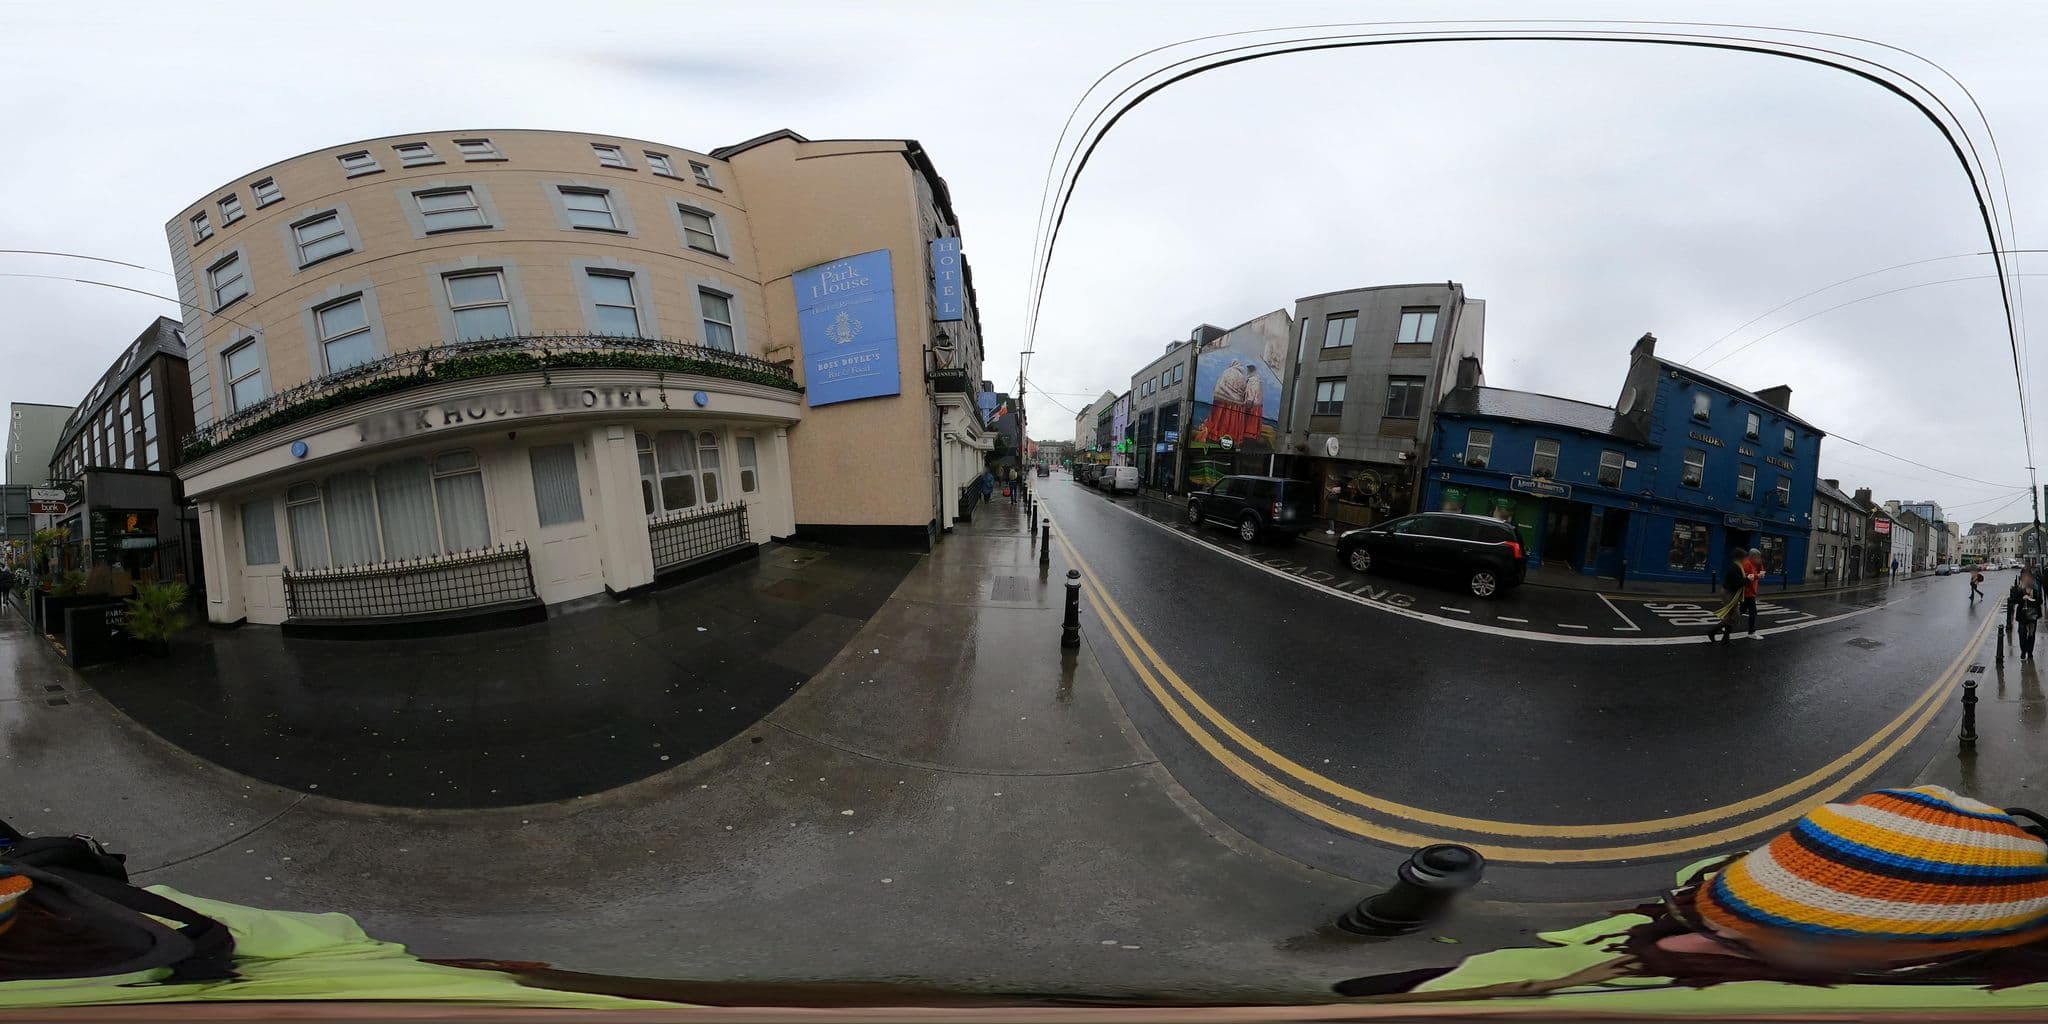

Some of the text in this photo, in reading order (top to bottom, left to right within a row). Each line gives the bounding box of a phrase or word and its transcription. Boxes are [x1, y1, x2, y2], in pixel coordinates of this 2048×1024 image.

[811, 277, 869, 299] House
[821, 265, 860, 295] Park
[940, 243, 955, 313] HOTEL
[841, 353, 881, 366] DOYLE'S
[1689, 431, 1726, 448] GARDEN
